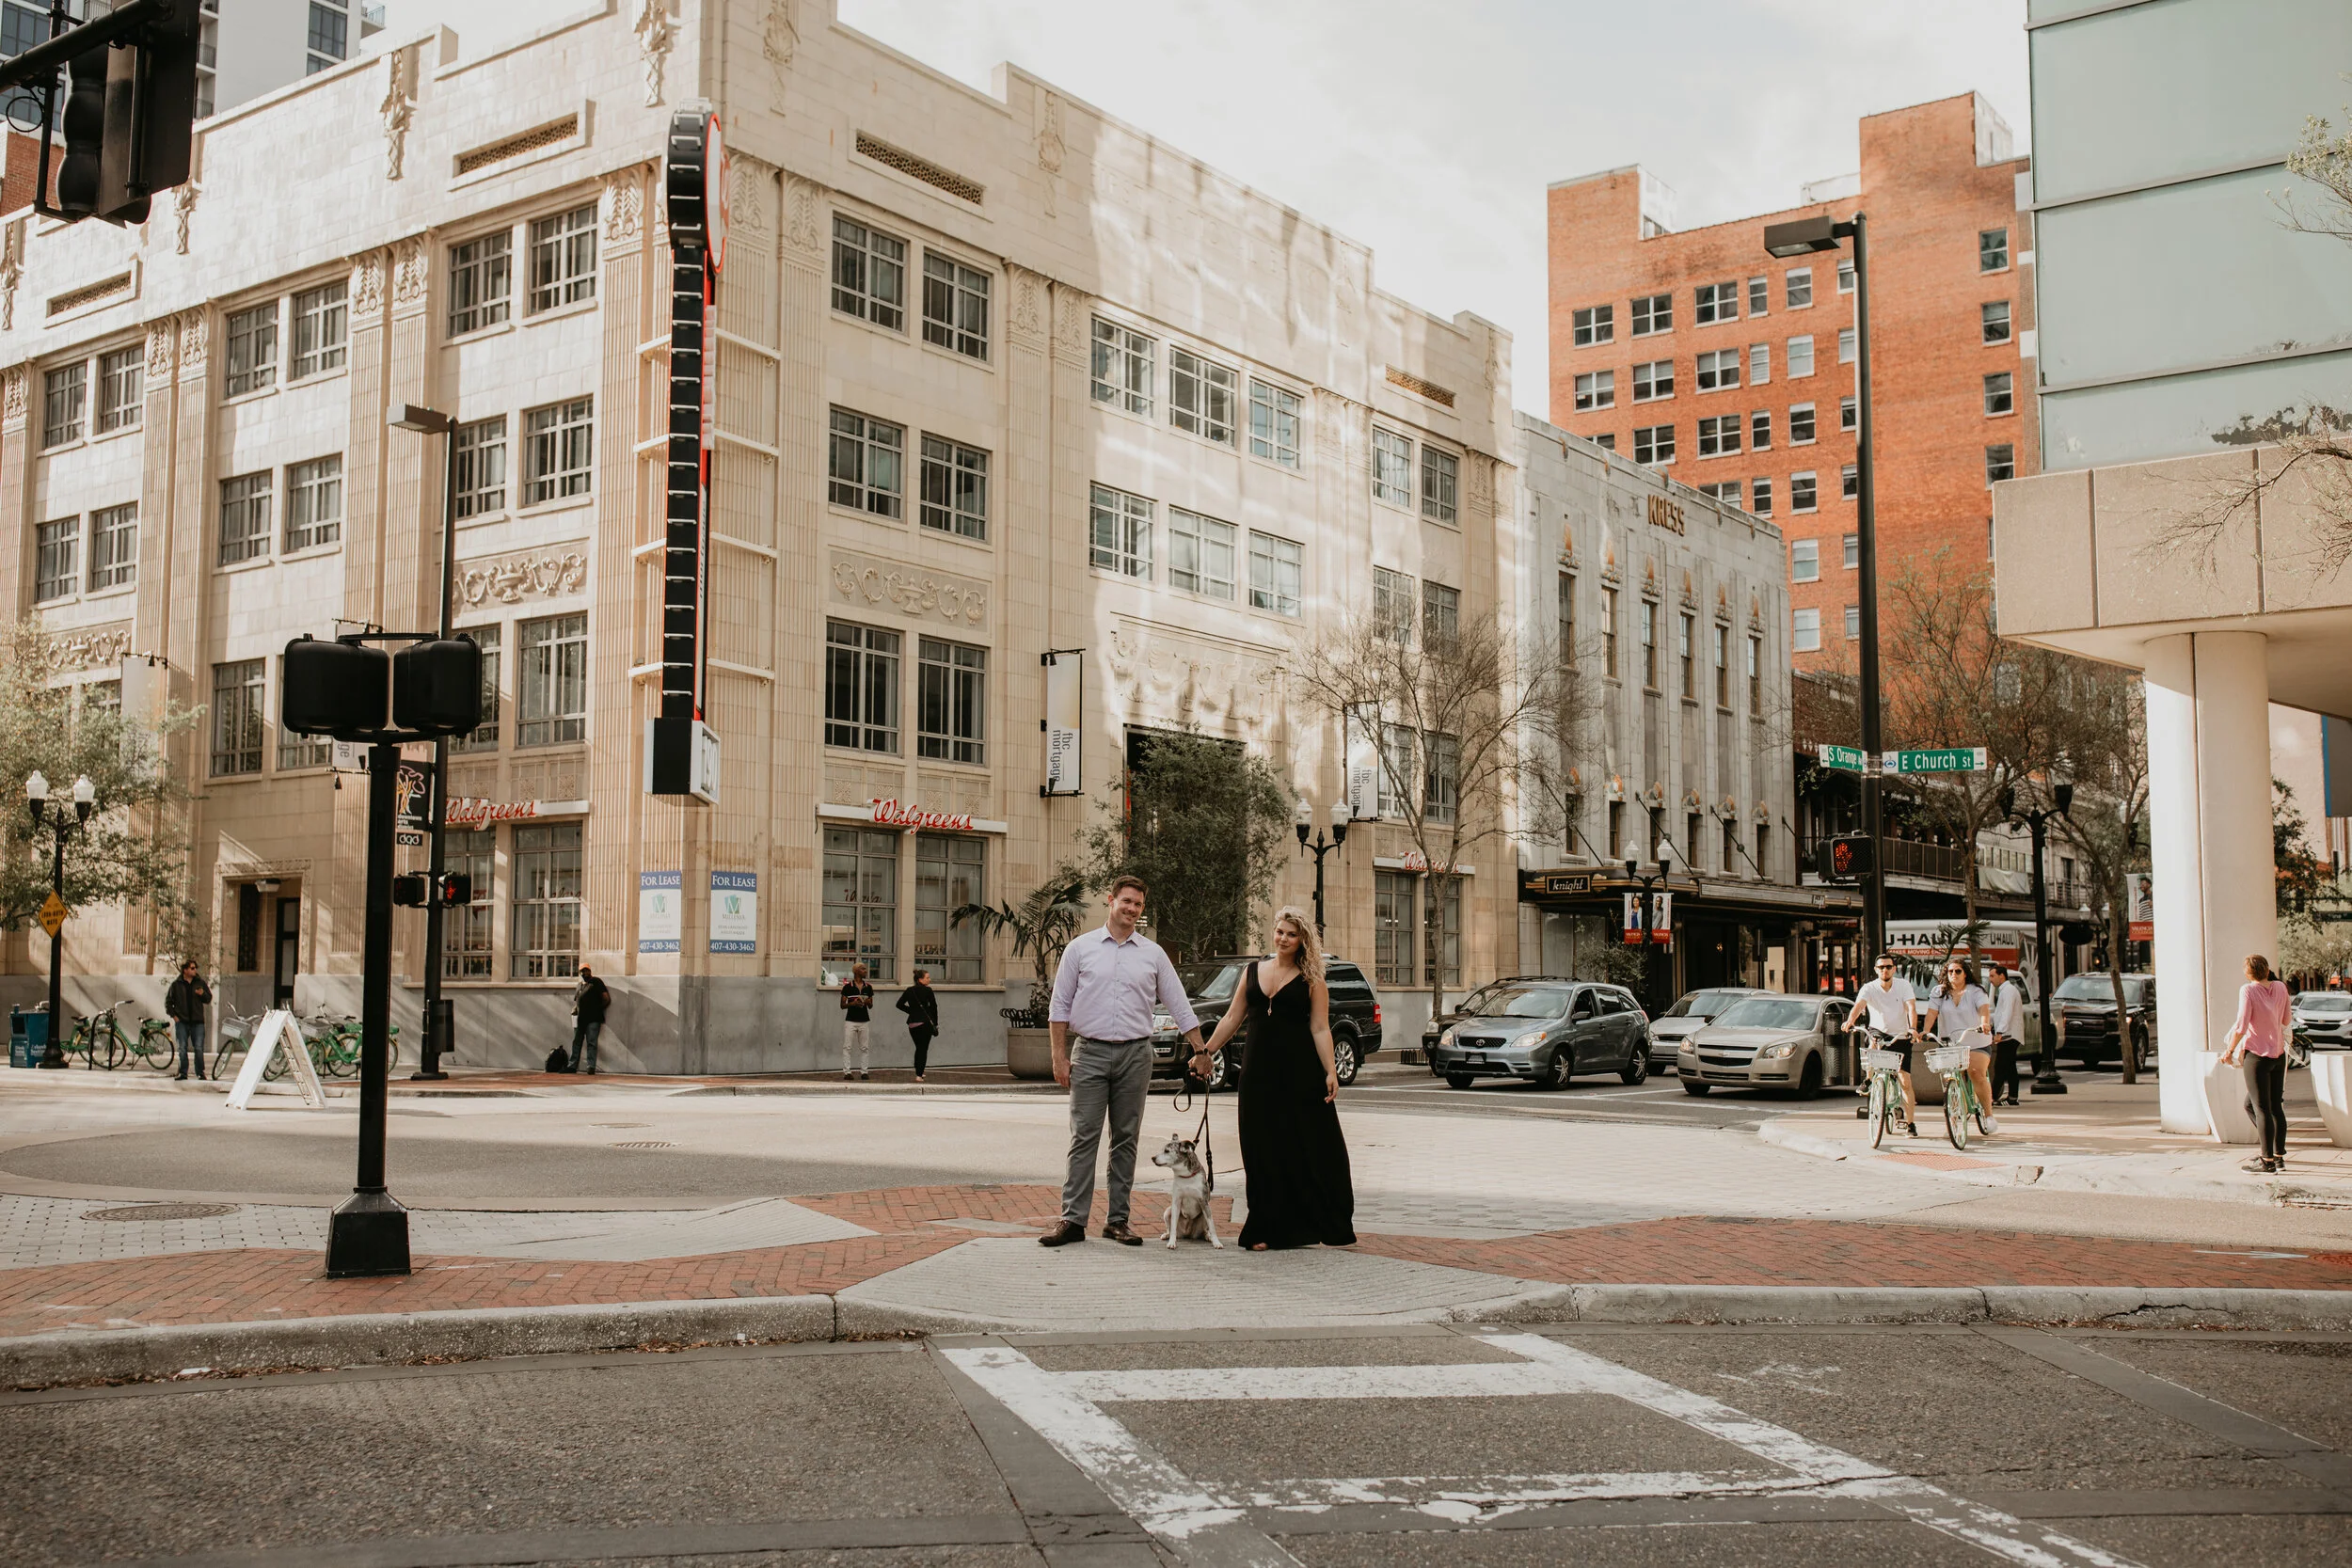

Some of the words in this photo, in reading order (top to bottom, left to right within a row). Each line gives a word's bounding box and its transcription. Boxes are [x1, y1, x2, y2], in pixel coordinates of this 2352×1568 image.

[1647, 494, 1685, 537] KRESS
[1061, 733, 1073, 750] fbc
[1828, 747, 1835, 762] S
[1836, 747, 1857, 768] Orange
[1901, 754, 1909, 770] E
[1914, 752, 1957, 769] Church
[1361, 769, 1372, 784] fbc
[872, 799, 975, 835] Walgreens
[641, 875, 658, 886] FOR
[659, 875, 681, 885] LEASE
[712, 875, 730, 886] FOR
[733, 876, 756, 887] LEASE
[1552, 879, 1583, 895] knight
[640, 942, 679, 951] 407-430-3462
[710, 942, 755, 951] 407-430-3462
